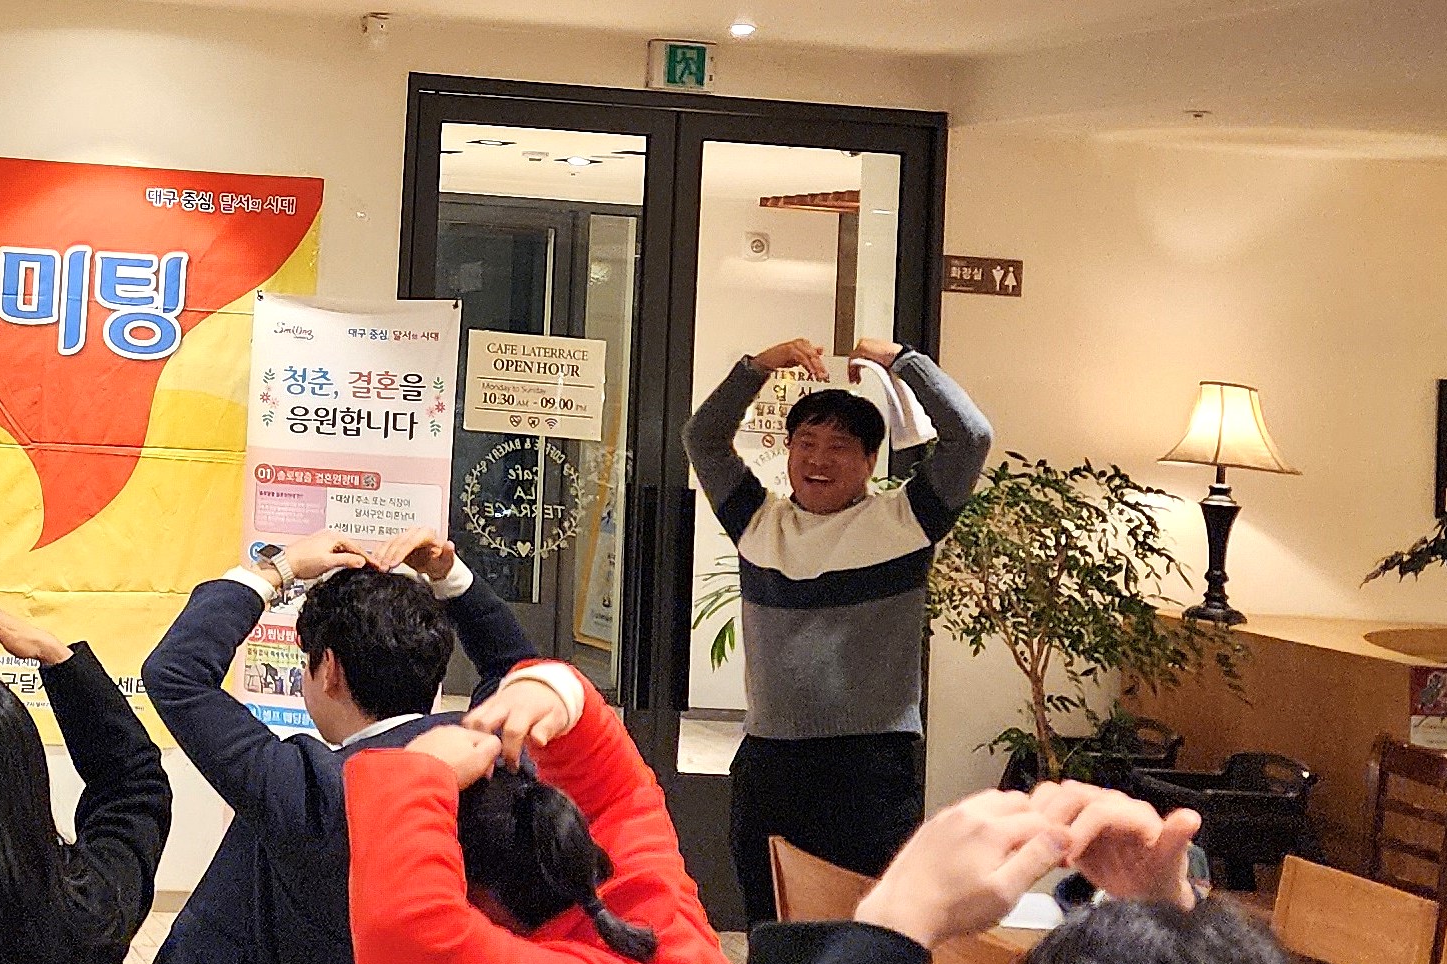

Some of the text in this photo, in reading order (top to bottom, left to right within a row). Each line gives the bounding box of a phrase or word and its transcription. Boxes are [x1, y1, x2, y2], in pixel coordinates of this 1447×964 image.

[146, 189, 177, 207] 대구
[219, 193, 261, 214] 달서의
[264, 196, 296, 214] 시대
[950, 266, 983, 281] 화장실
[348, 328, 367, 338] 대구
[420, 331, 440, 341] 시대
[486, 342, 589, 361] CAFE LATERRACE
[493, 358, 581, 377] OPEN HOUR
[282, 366, 427, 402] 청춘, 결혼을
[482, 382, 510, 393] Monday
[521, 386, 546, 394] Sunday
[482, 392, 515, 406] 10:30
[575, 404, 587, 412] PM
[285, 405, 419, 441] 응원합니다
[257, 467, 272, 480] 01
